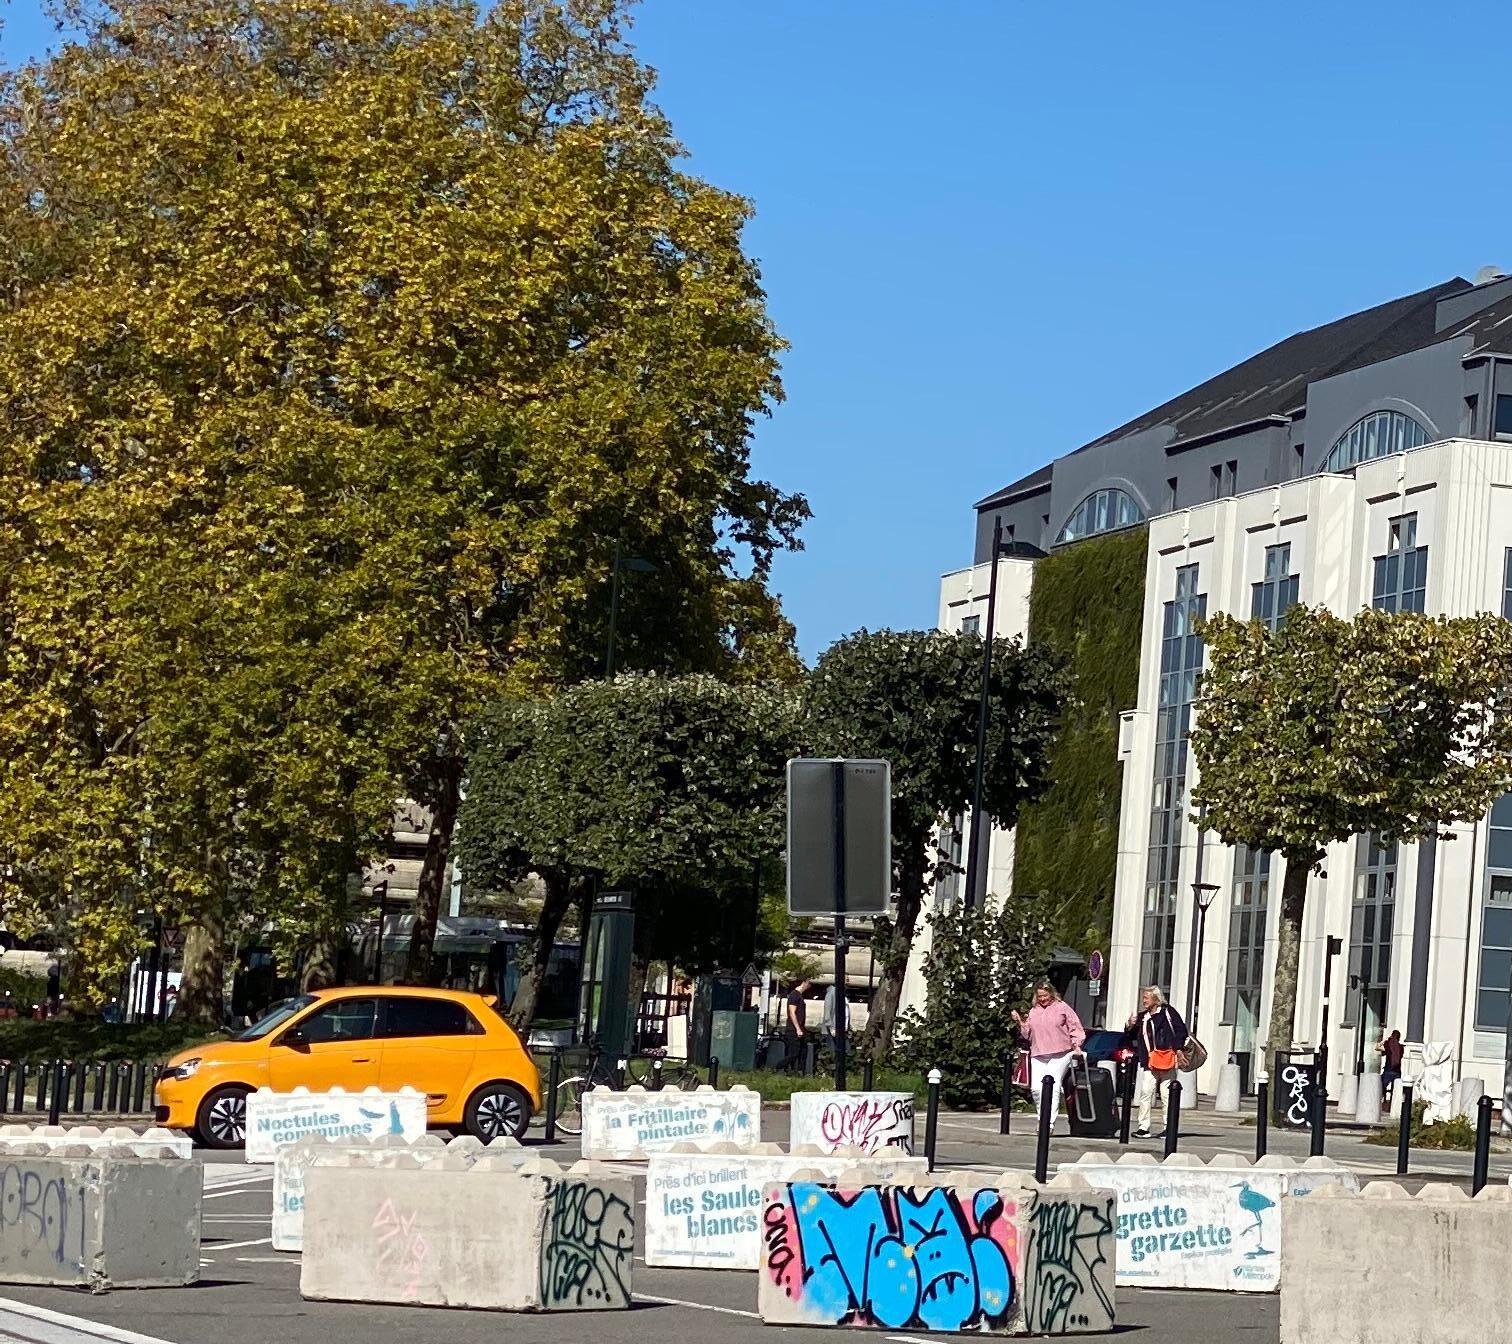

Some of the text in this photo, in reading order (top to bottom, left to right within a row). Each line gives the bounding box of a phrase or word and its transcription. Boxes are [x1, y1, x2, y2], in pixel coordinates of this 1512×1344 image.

[257, 1112, 341, 1132] Noctules
[605, 1106, 708, 1129] la Fritillaire
[637, 1122, 705, 1144] pintade
[654, 1166, 748, 1190] Près d'ici brillent
[663, 1192, 694, 1216] les
[687, 1214, 759, 1238] blancs
[1131, 1224, 1232, 1262] garzette
